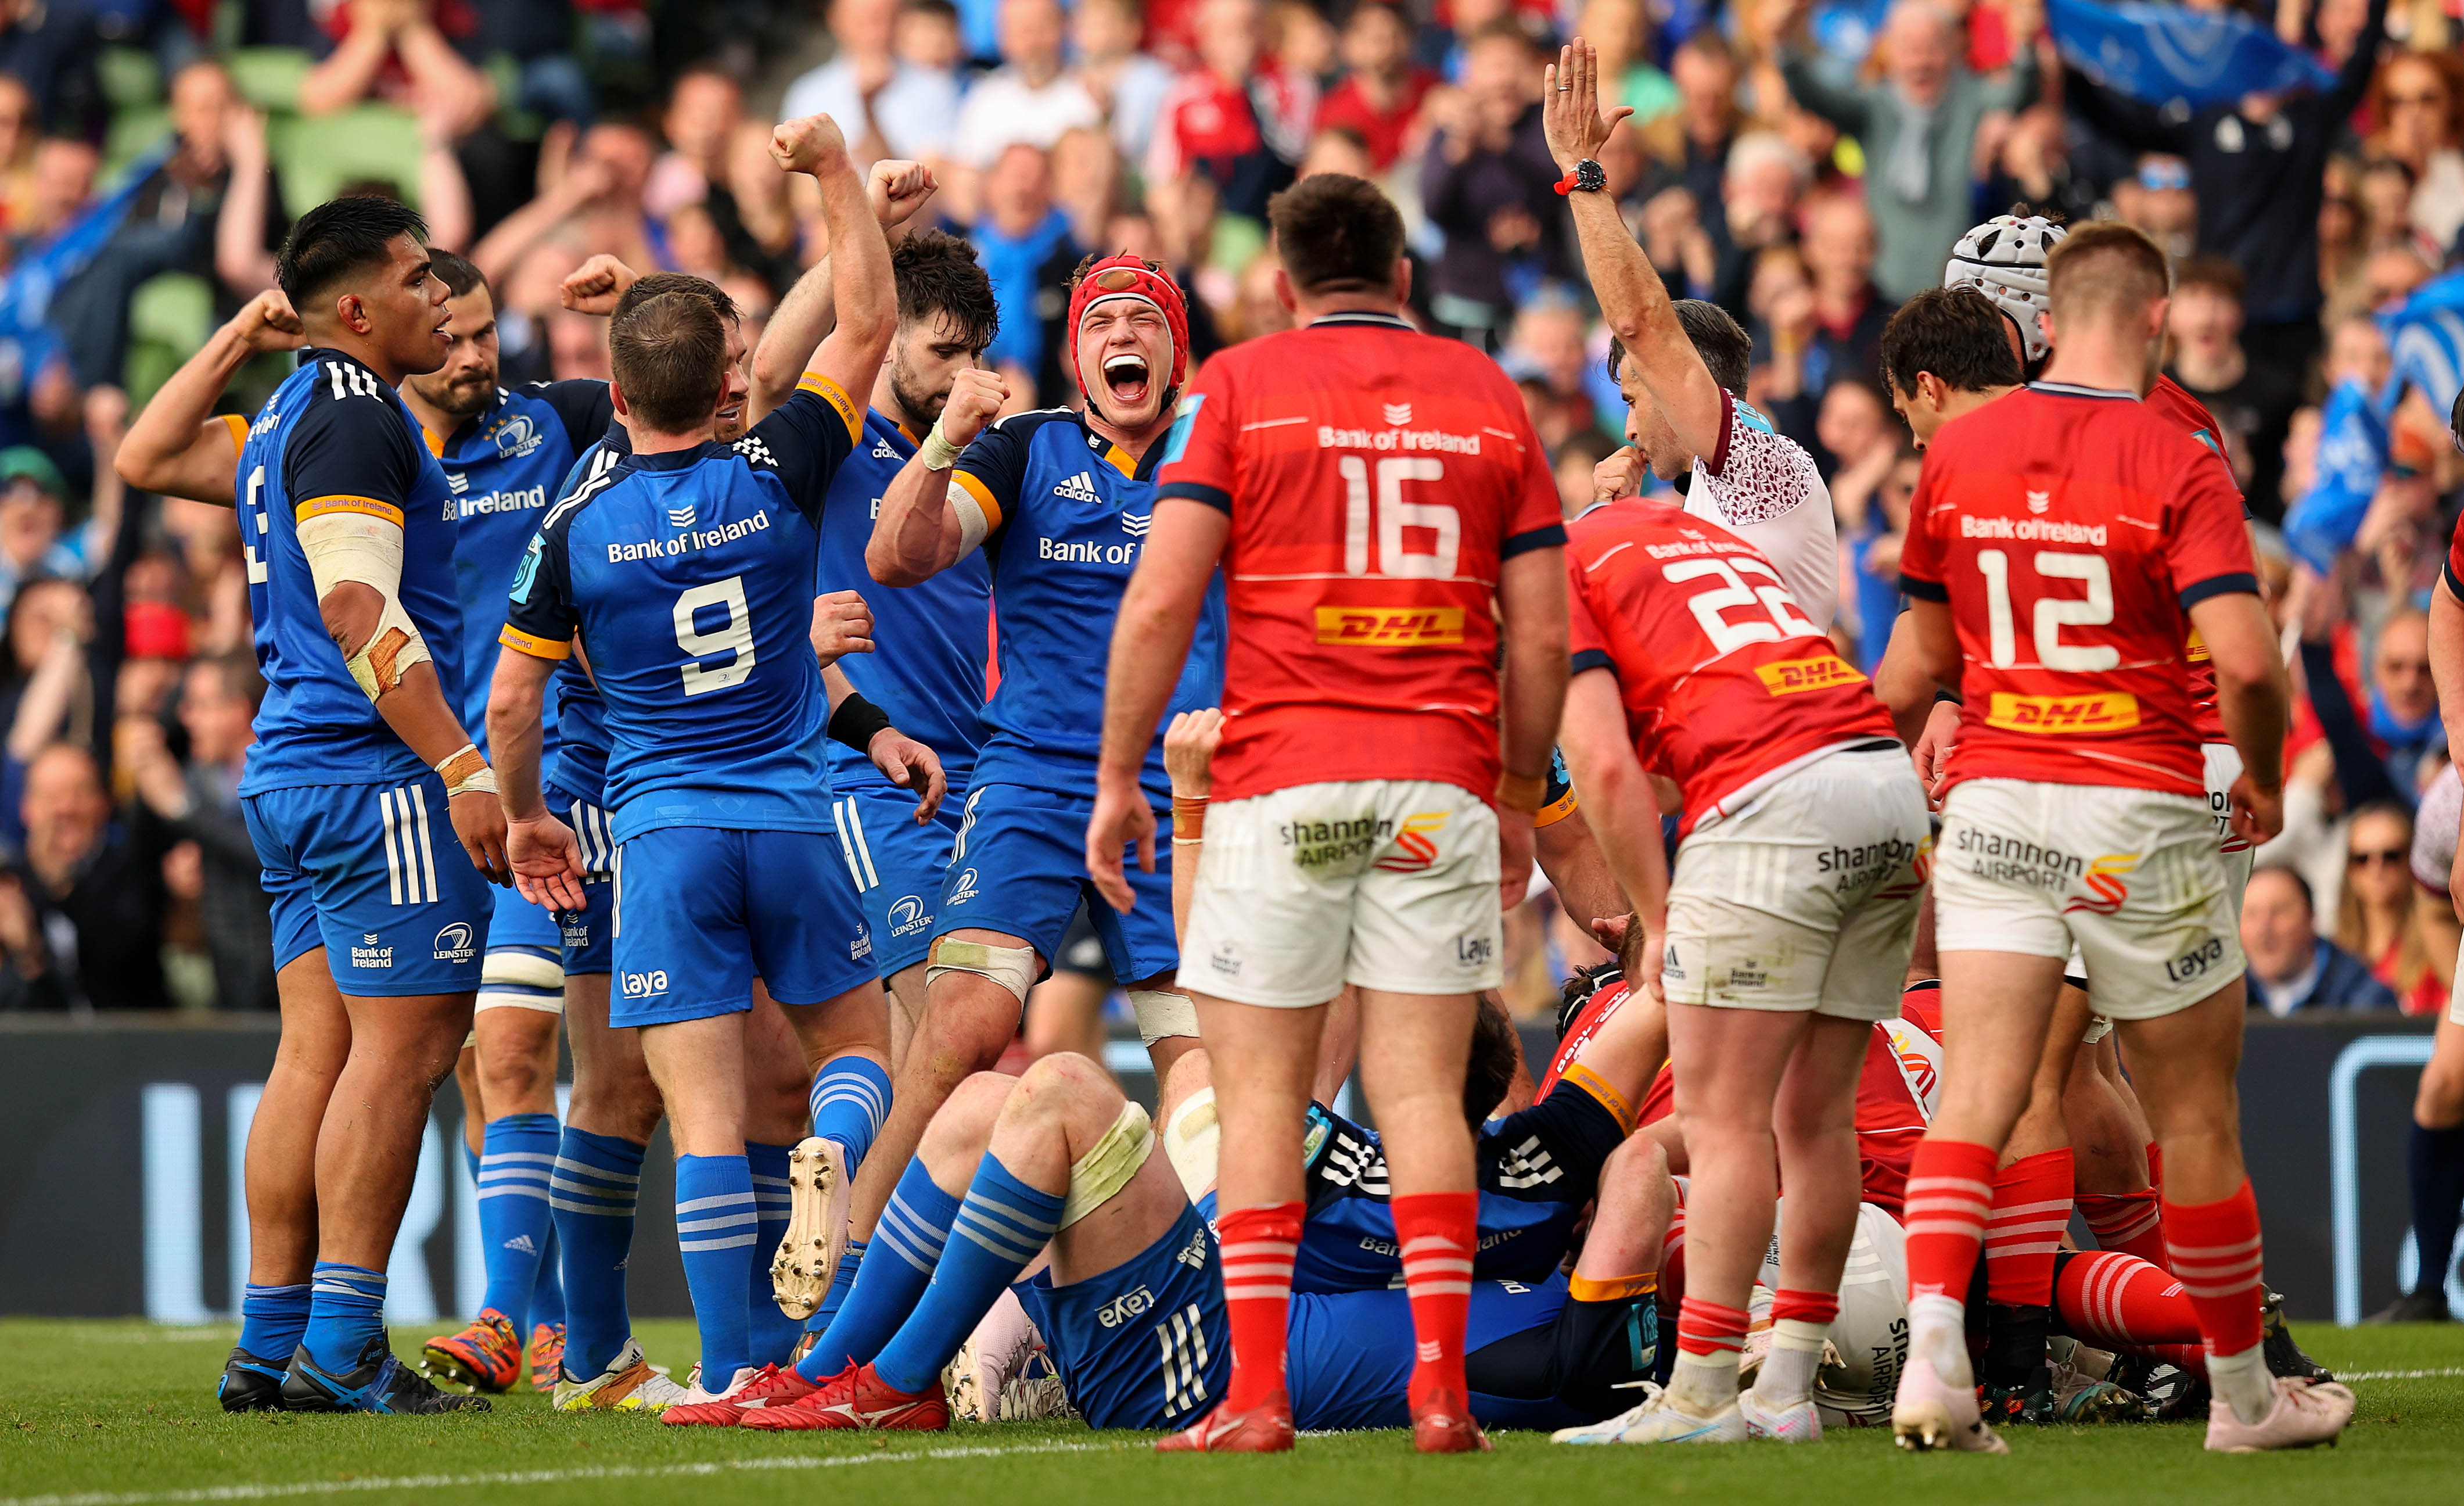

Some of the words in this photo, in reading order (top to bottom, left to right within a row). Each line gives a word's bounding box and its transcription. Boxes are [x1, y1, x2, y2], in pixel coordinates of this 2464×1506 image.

[831, 390, 849, 413] Bank
[499, 435, 543, 459] LEINSTER
[1317, 425, 1373, 450] Bank
[1373, 428, 1400, 451] of
[1401, 429, 1481, 456] Ireland
[872, 447, 907, 462] adid
[325, 500, 349, 508] Bank
[362, 500, 392, 515] Ireland
[442, 499, 459, 522] Ba
[459, 484, 546, 517] Ireland
[1339, 455, 1461, 581] 16
[1960, 514, 2016, 539] Bank
[2015, 517, 2041, 540] of
[2040, 519, 2107, 547] Ireland
[607, 539, 665, 564] Bank
[666, 536, 688, 556] of
[692, 510, 770, 551] Ireland
[1039, 537, 1102, 564] Bank
[1106, 542, 1136, 565] of
[1662, 556, 1829, 655] 22
[1977, 549, 2121, 673] 12
[673, 575, 756, 697] 9
[1339, 614, 1444, 637] DHL
[506, 633, 533, 650] Ireland
[1779, 661, 1848, 687] DHL
[2013, 701, 2114, 727] DHL
[1280, 820, 1393, 847] shannn
[1957, 826, 2082, 877] shannon
[1971, 858, 2068, 892] AIRPORT
[562, 926, 579, 937] Bank
[579, 926, 588, 937] of
[891, 916, 933, 938] LEINSTER
[909, 927, 926, 936] RUGBY
[351, 946, 379, 958] Bank
[380, 946, 394, 958] of
[433, 948, 475, 959] LEINSTER
[565, 936, 589, 947] Ireland
[352, 958, 392, 968] Ireland
[2165, 938, 2223, 982] laya
[621, 970, 668, 998] laya
[1359, 1236, 1400, 1257] Ban
[1098, 1289, 1155, 1328] laya
